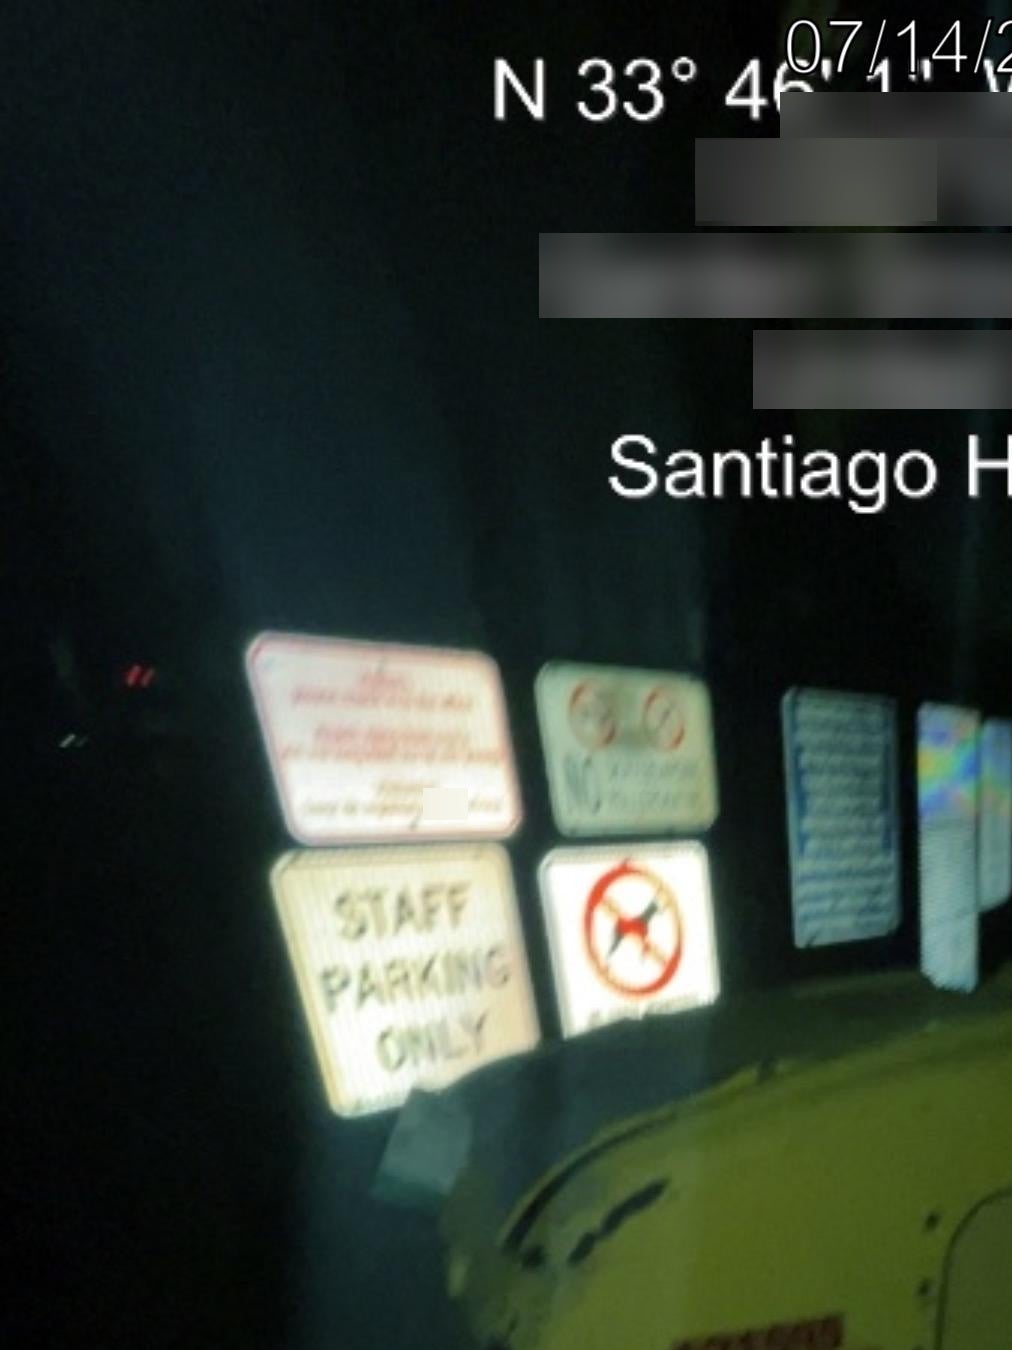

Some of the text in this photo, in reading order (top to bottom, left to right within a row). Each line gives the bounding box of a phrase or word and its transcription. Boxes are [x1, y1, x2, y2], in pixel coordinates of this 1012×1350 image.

[336, 881, 472, 940] STAFF
[321, 947, 511, 1014] PARKING
[376, 1012, 487, 1072] ONLY
